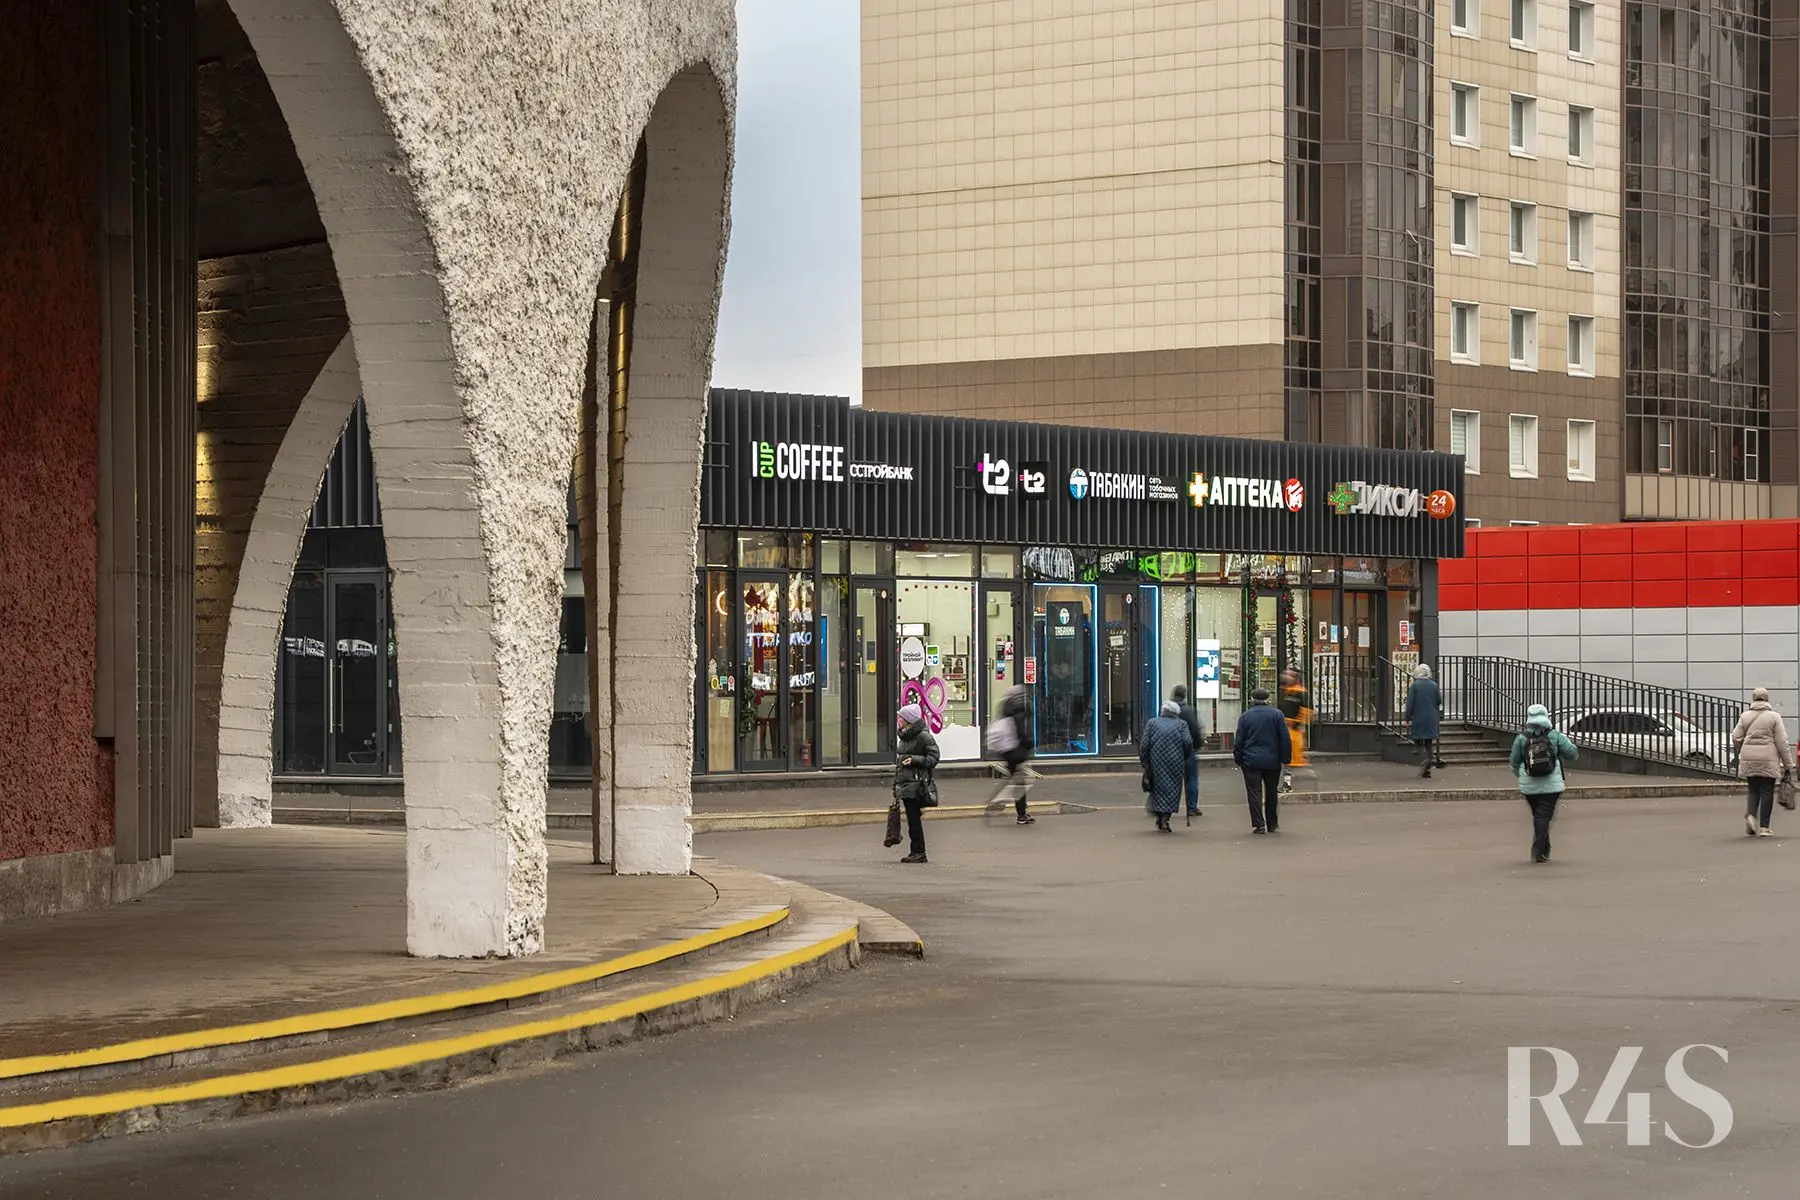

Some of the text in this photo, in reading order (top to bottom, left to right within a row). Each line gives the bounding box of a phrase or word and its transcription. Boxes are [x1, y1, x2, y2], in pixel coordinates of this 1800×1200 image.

[760, 442, 775, 478] CUP
[776, 442, 844, 482] COFFEE
[978, 453, 1010, 495] t2
[1020, 469, 1045, 493] t2
[1089, 472, 1145, 500] ТАБАКИН
[1210, 476, 1284, 508] АПТЕКА
[1350, 481, 1419, 518] ДИКСИ
[1431, 495, 1446, 506] 24
